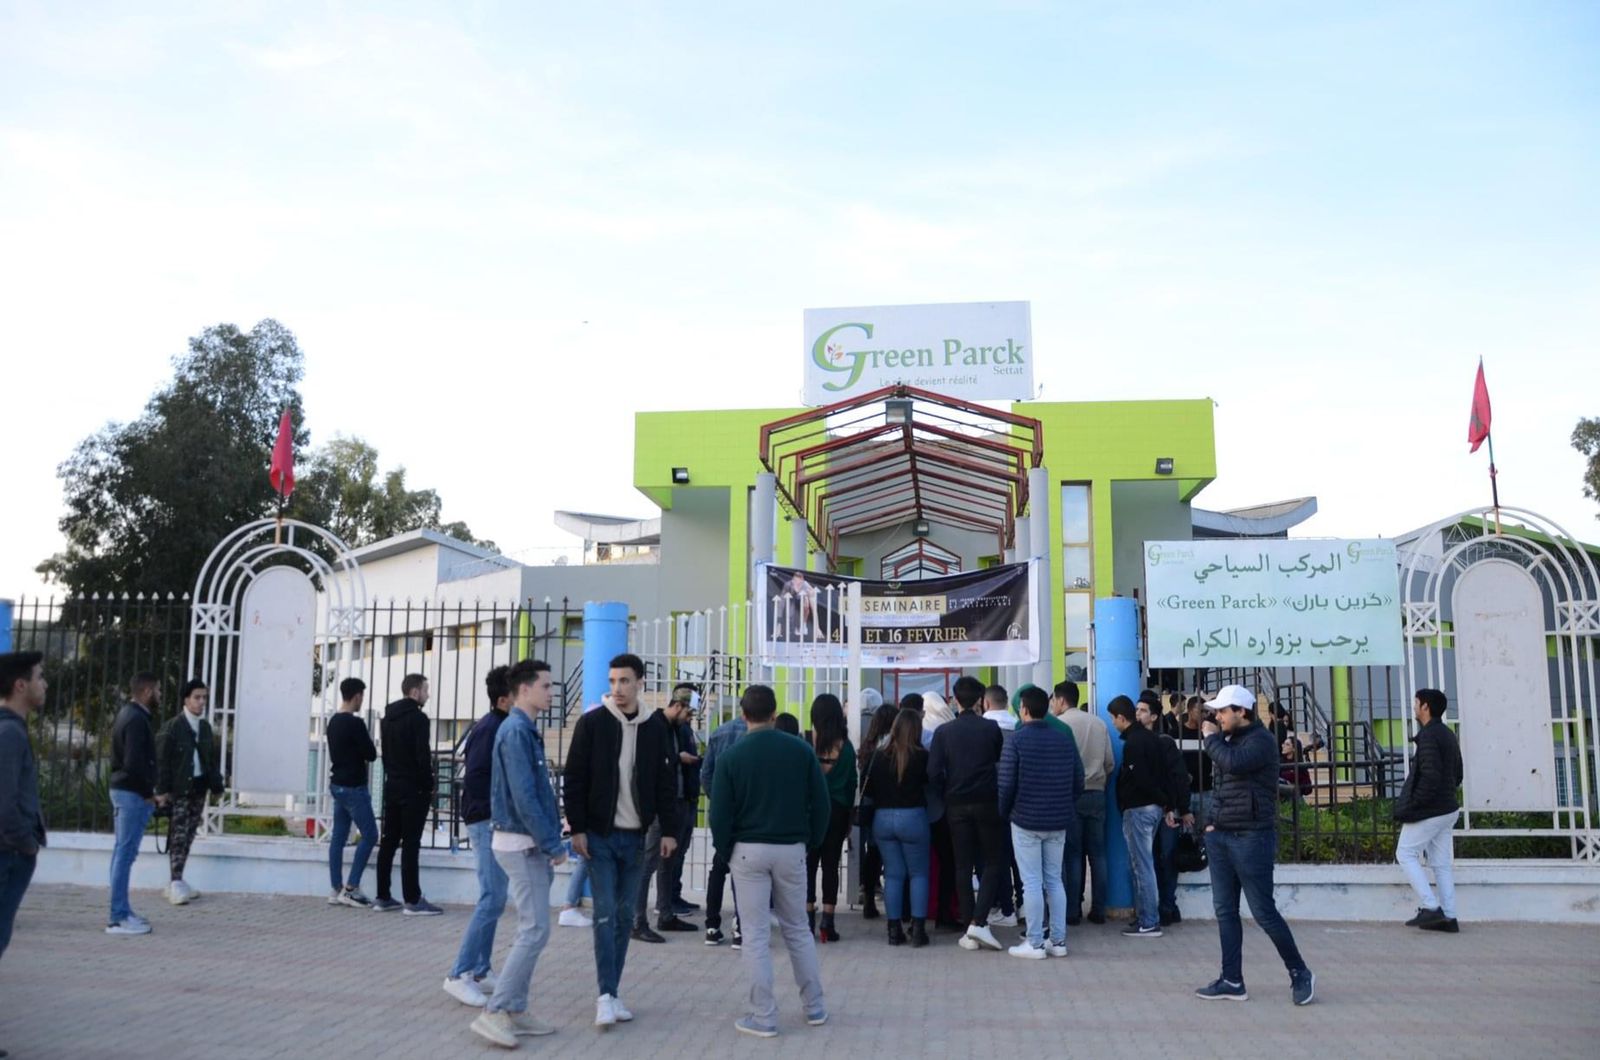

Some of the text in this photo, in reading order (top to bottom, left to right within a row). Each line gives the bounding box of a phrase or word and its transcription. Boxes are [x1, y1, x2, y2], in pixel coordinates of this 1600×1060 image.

[811, 322, 1024, 392] Green Parck
[993, 365, 1024, 375] Settat
[915, 376, 945, 386] devient
[948, 374, 978, 385] réalité
[1194, 552, 1342, 584] المركب السياحي
[864, 599, 941, 612] SEMINAIRE
[864, 628, 883, 643] ET
[888, 628, 902, 643] 16
[907, 626, 968, 642] FEVRIER
[1182, 628, 1369, 658] يرحب بزواره الكرام
